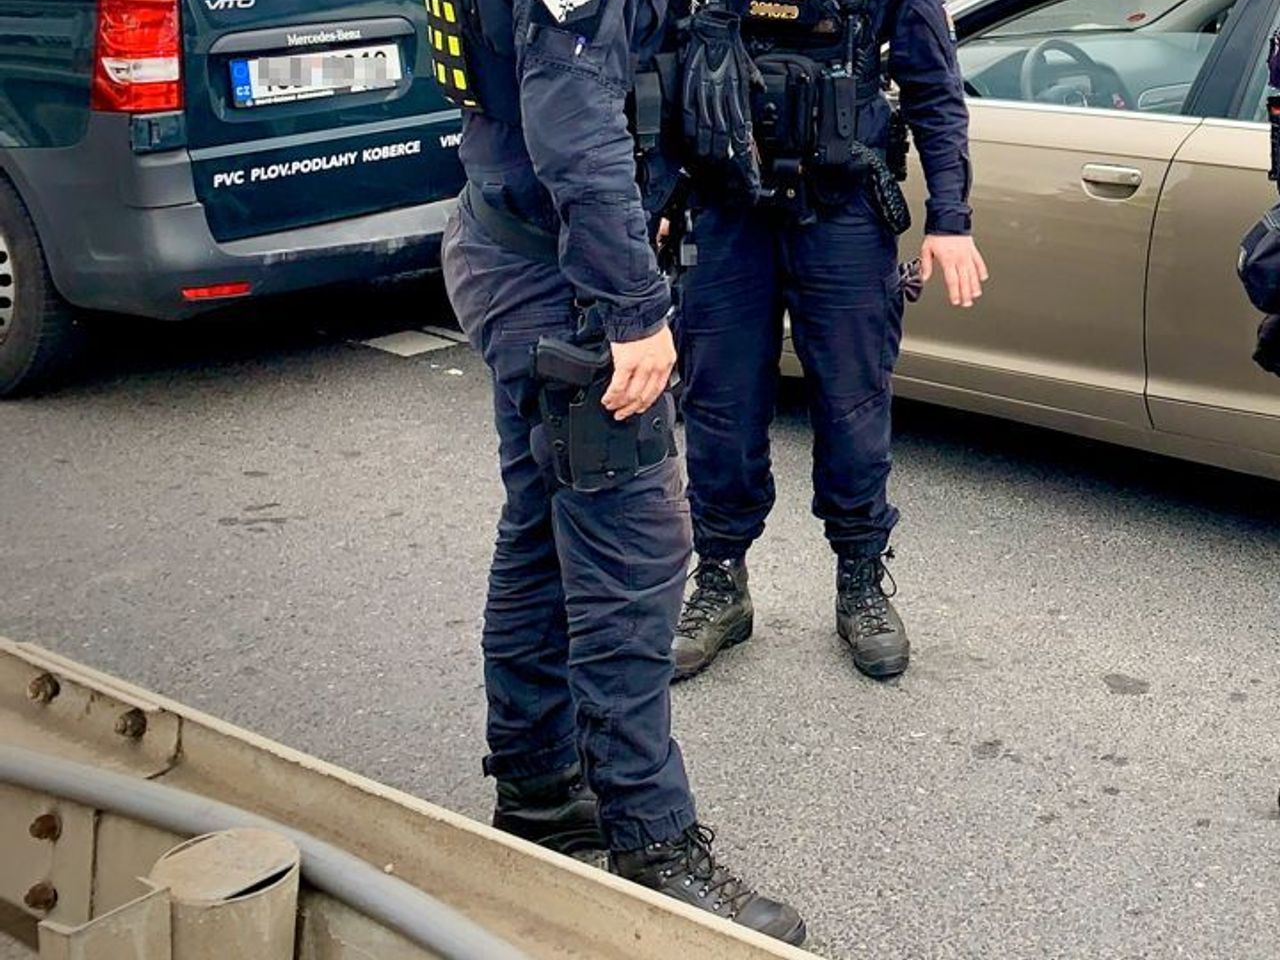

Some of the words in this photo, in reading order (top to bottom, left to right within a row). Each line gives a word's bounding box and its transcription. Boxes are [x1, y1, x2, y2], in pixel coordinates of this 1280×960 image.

[286, 28, 361, 47] Mercedes-Benz
[213, 170, 245, 188] PVC
[250, 151, 358, 182] PLOV.PODLAHY
[362, 140, 421, 162] KOBERCE
